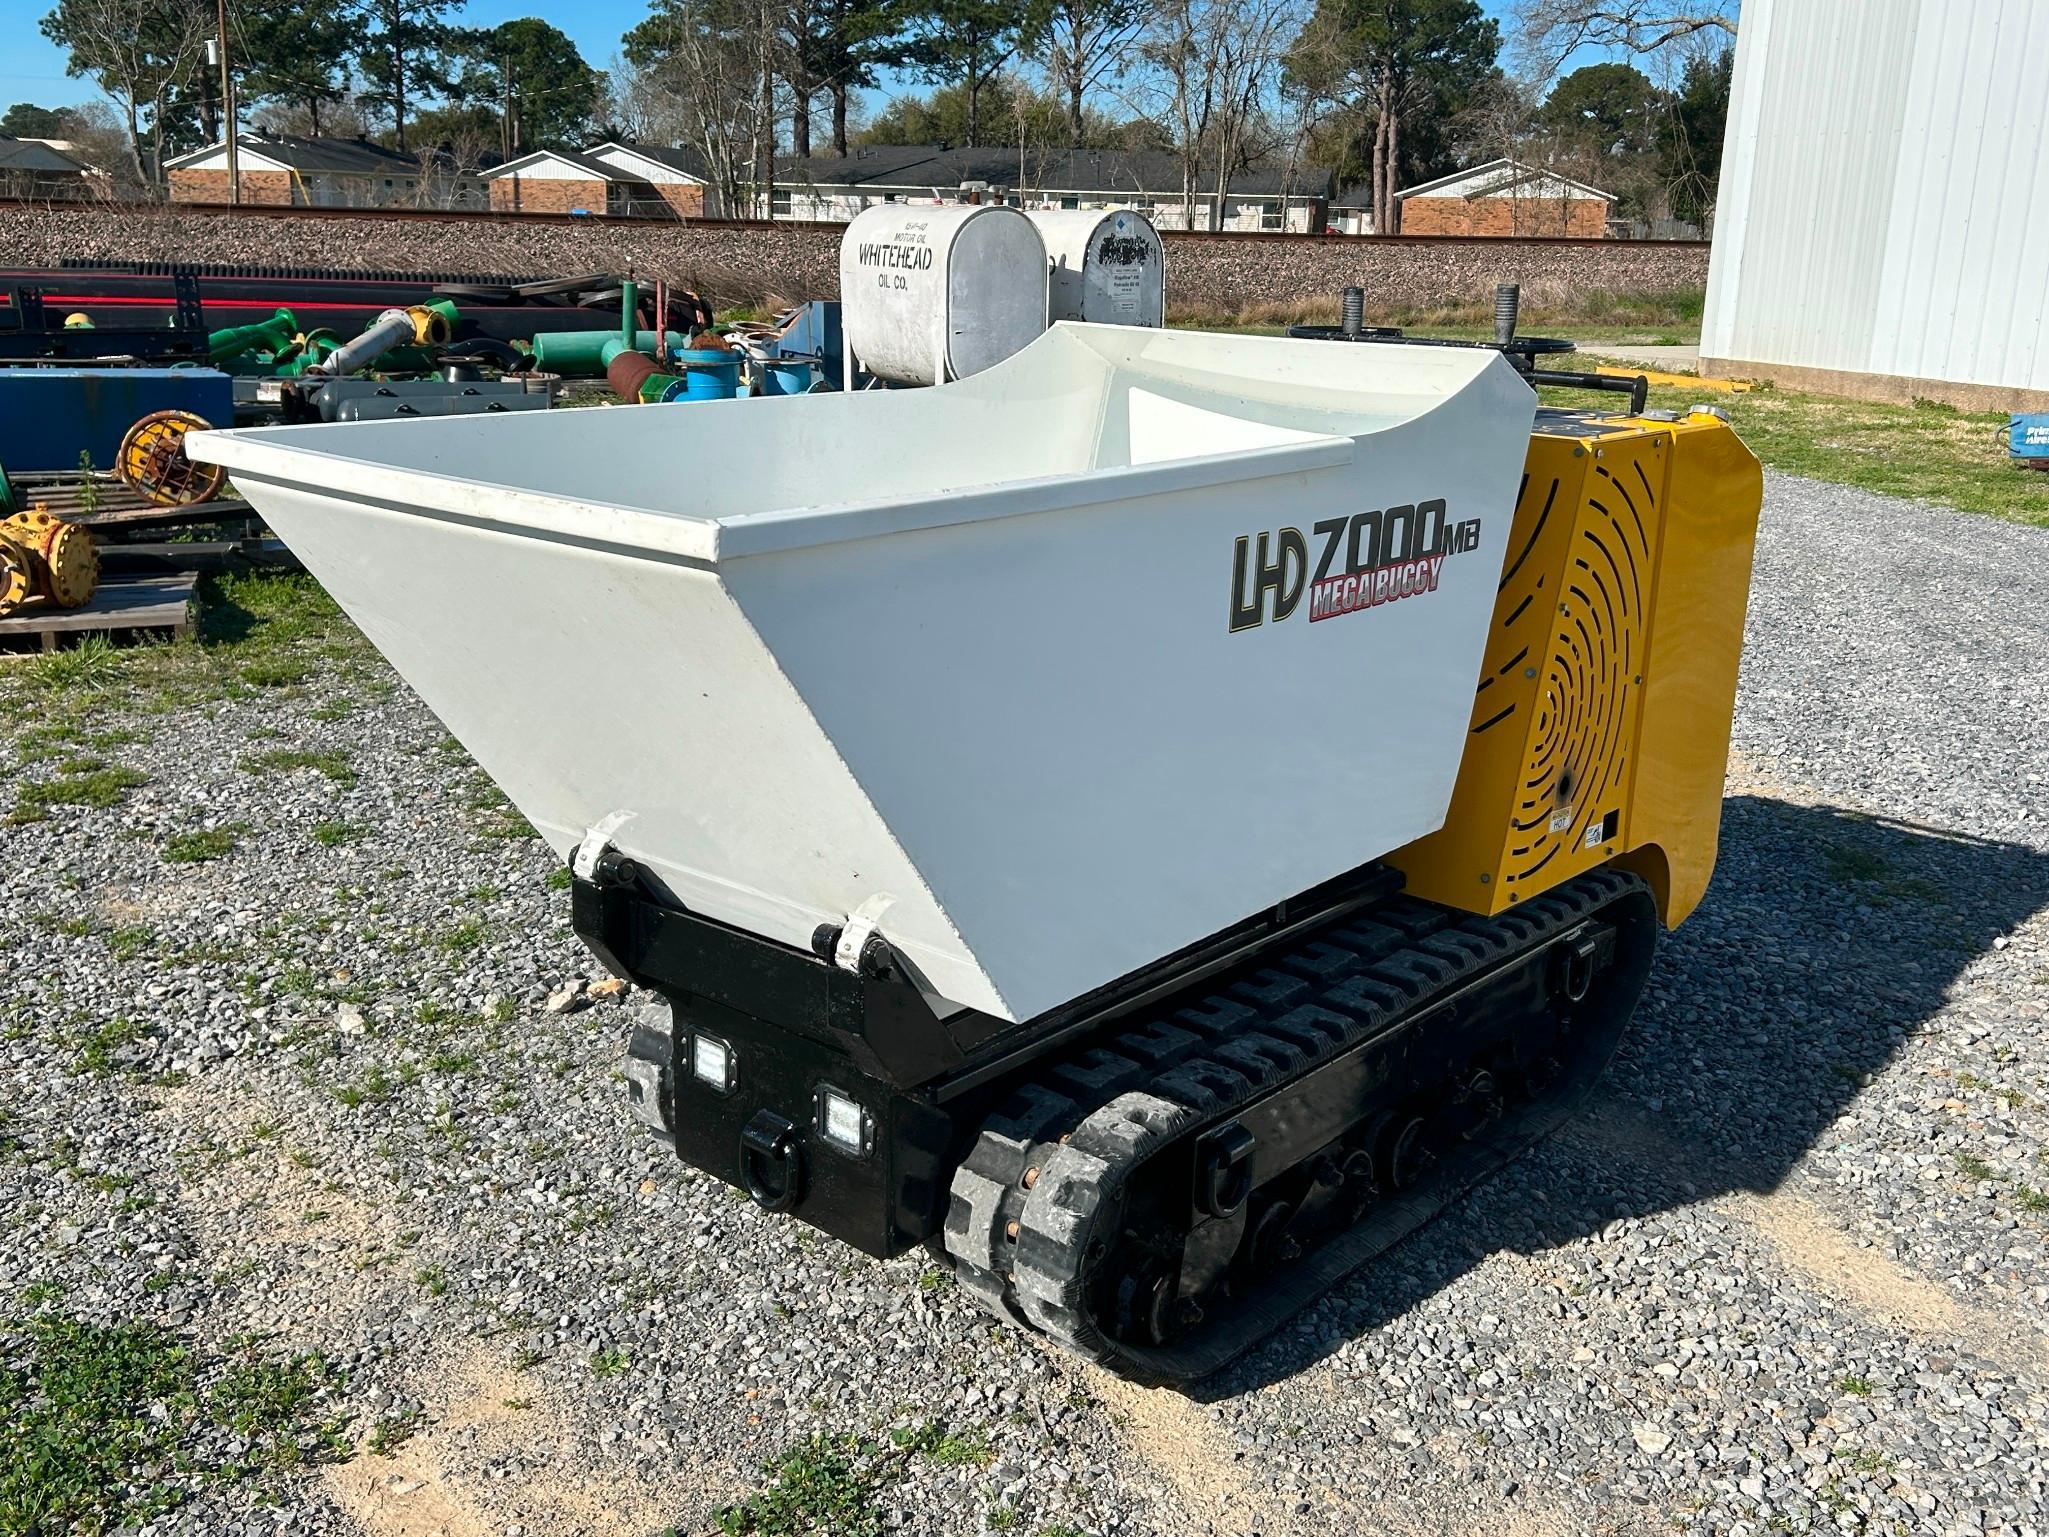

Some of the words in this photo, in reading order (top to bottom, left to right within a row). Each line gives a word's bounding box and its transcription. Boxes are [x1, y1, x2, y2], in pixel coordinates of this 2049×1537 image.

[894, 232, 915, 243] MOTOR
[916, 234, 926, 244] OIL
[859, 243, 932, 270] WHITEHEAD
[878, 273, 890, 288] OIL
[1229, 527, 1308, 633] LHD
[1553, 818, 1567, 830] HOT
